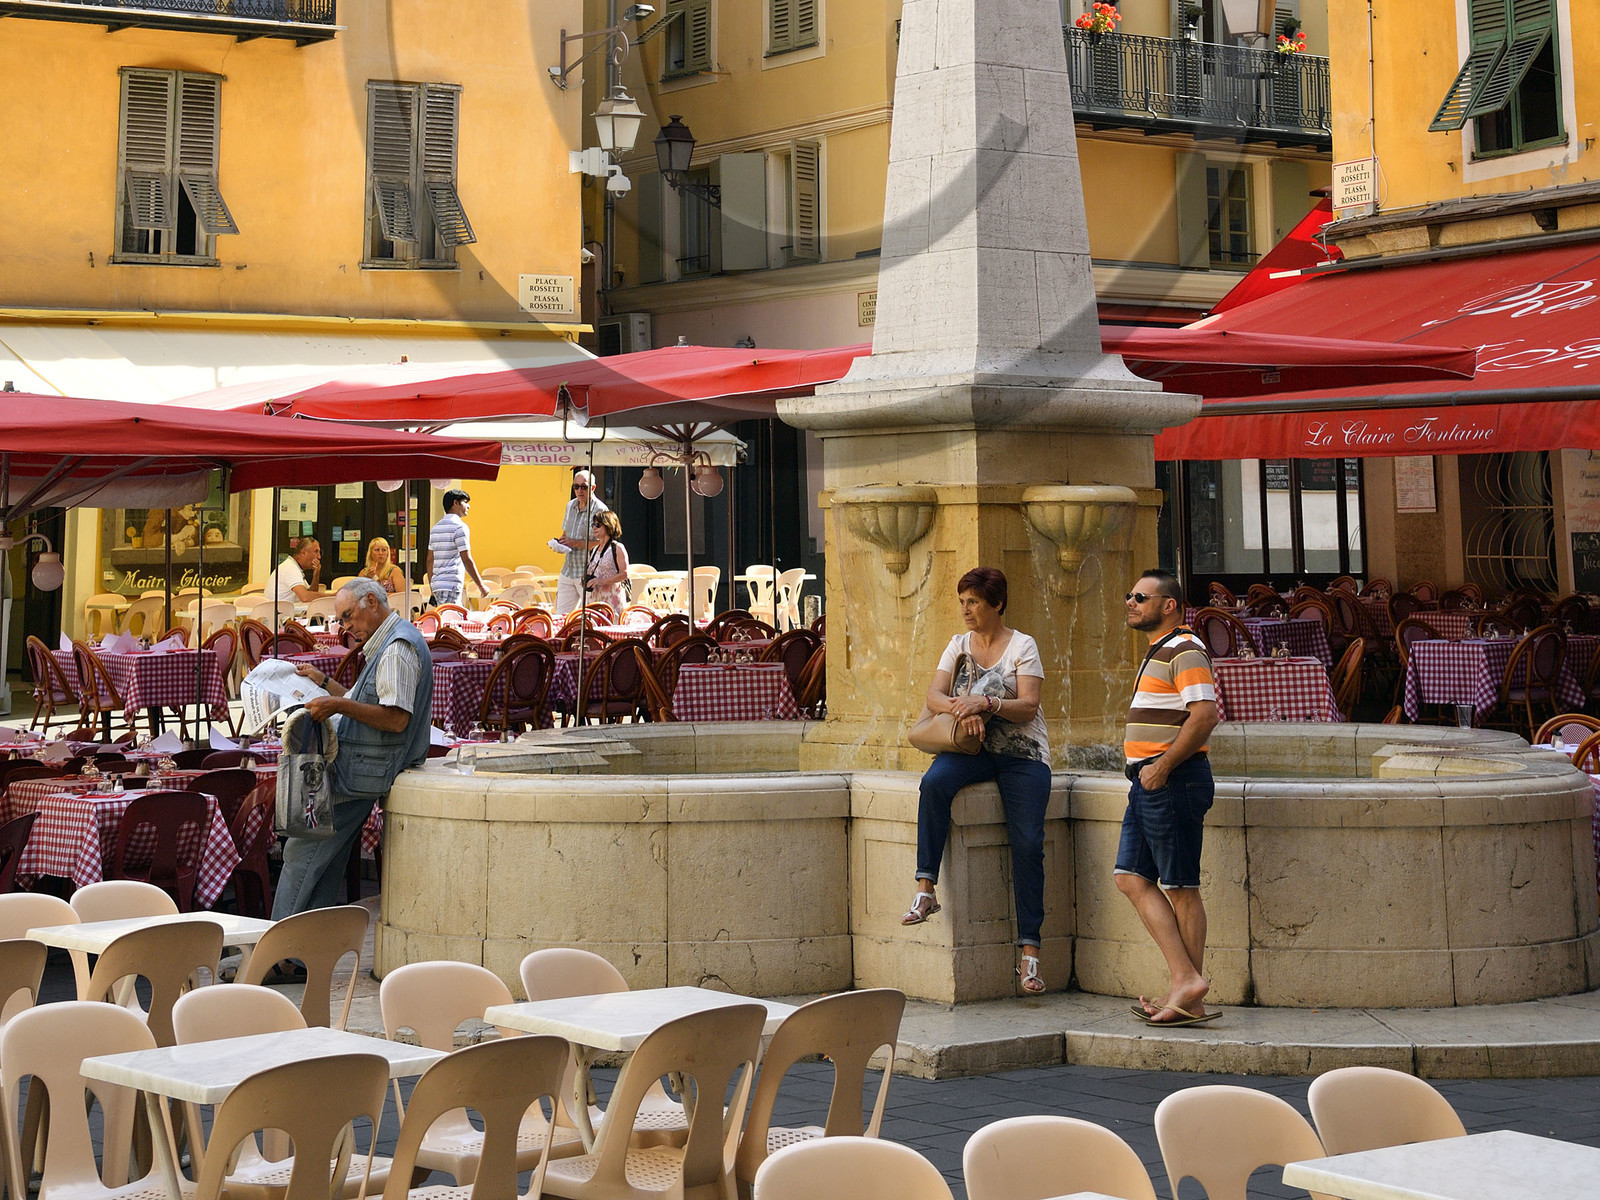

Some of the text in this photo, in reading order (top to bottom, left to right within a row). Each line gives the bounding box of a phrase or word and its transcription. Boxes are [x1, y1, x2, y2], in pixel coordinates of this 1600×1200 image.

[1345, 164, 1365, 174] PLACE
[1340, 172, 1370, 183] ROSSETTI
[1344, 185, 1367, 195] PLASSA
[1341, 193, 1370, 204] ROSSETTI
[529, 285, 564, 293] ROSSETTI
[533, 295, 560, 303] PLASSA
[1304, 417, 1494, 447] La Claire Fontaine
[502, 443, 575, 452] ication
[501, 453, 571, 463] sanale
[176, 568, 232, 592] Glacier
